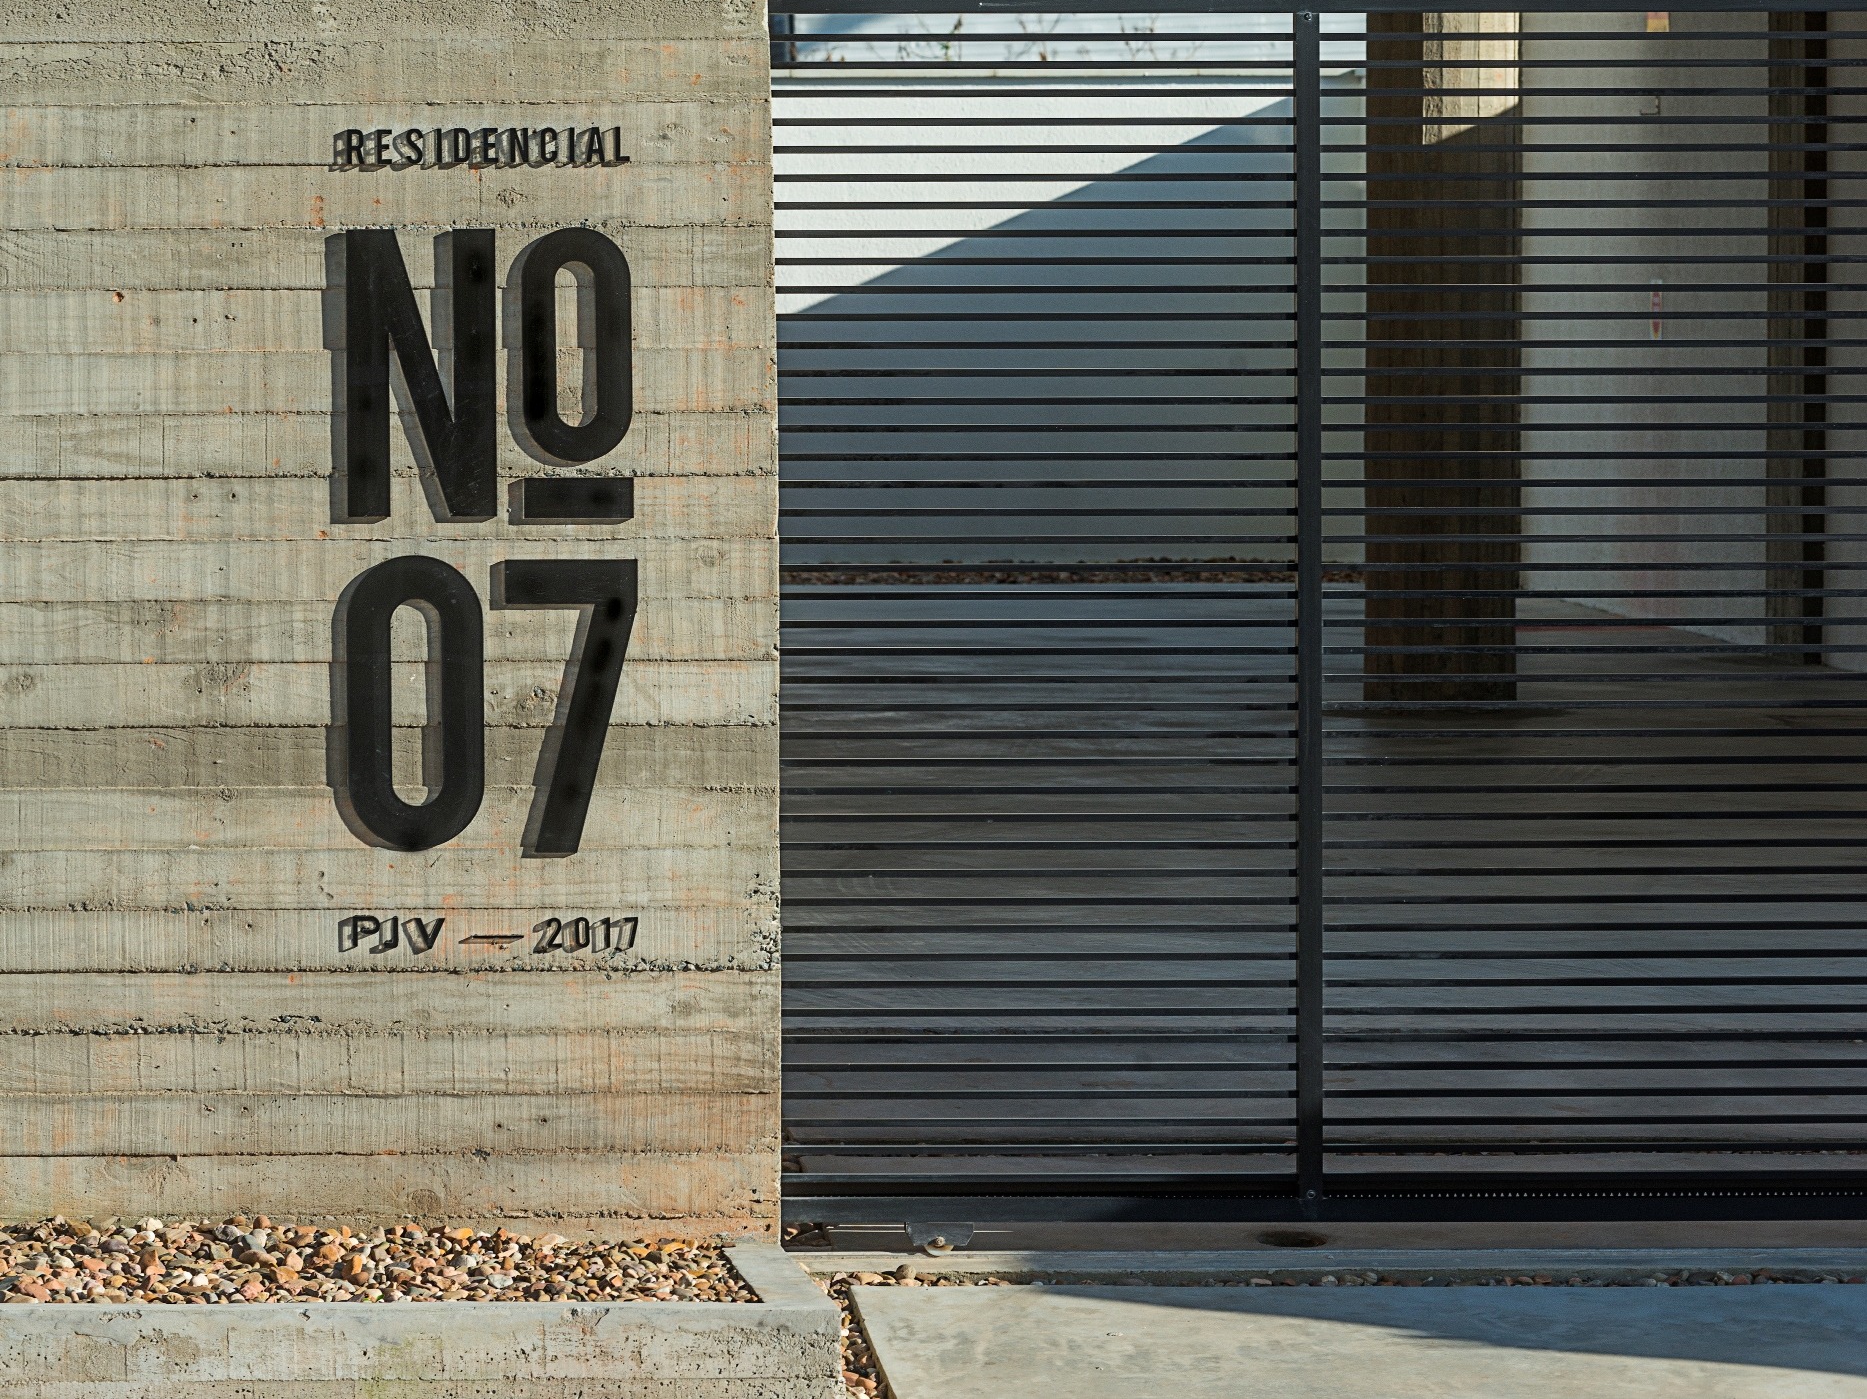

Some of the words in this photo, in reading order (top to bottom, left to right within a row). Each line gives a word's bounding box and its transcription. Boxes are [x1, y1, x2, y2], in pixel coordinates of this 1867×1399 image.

[345, 126, 631, 164] RESIDENCIAL
[345, 555, 639, 855] 07
[350, 914, 446, 951] PJV
[543, 916, 639, 949] 2017
